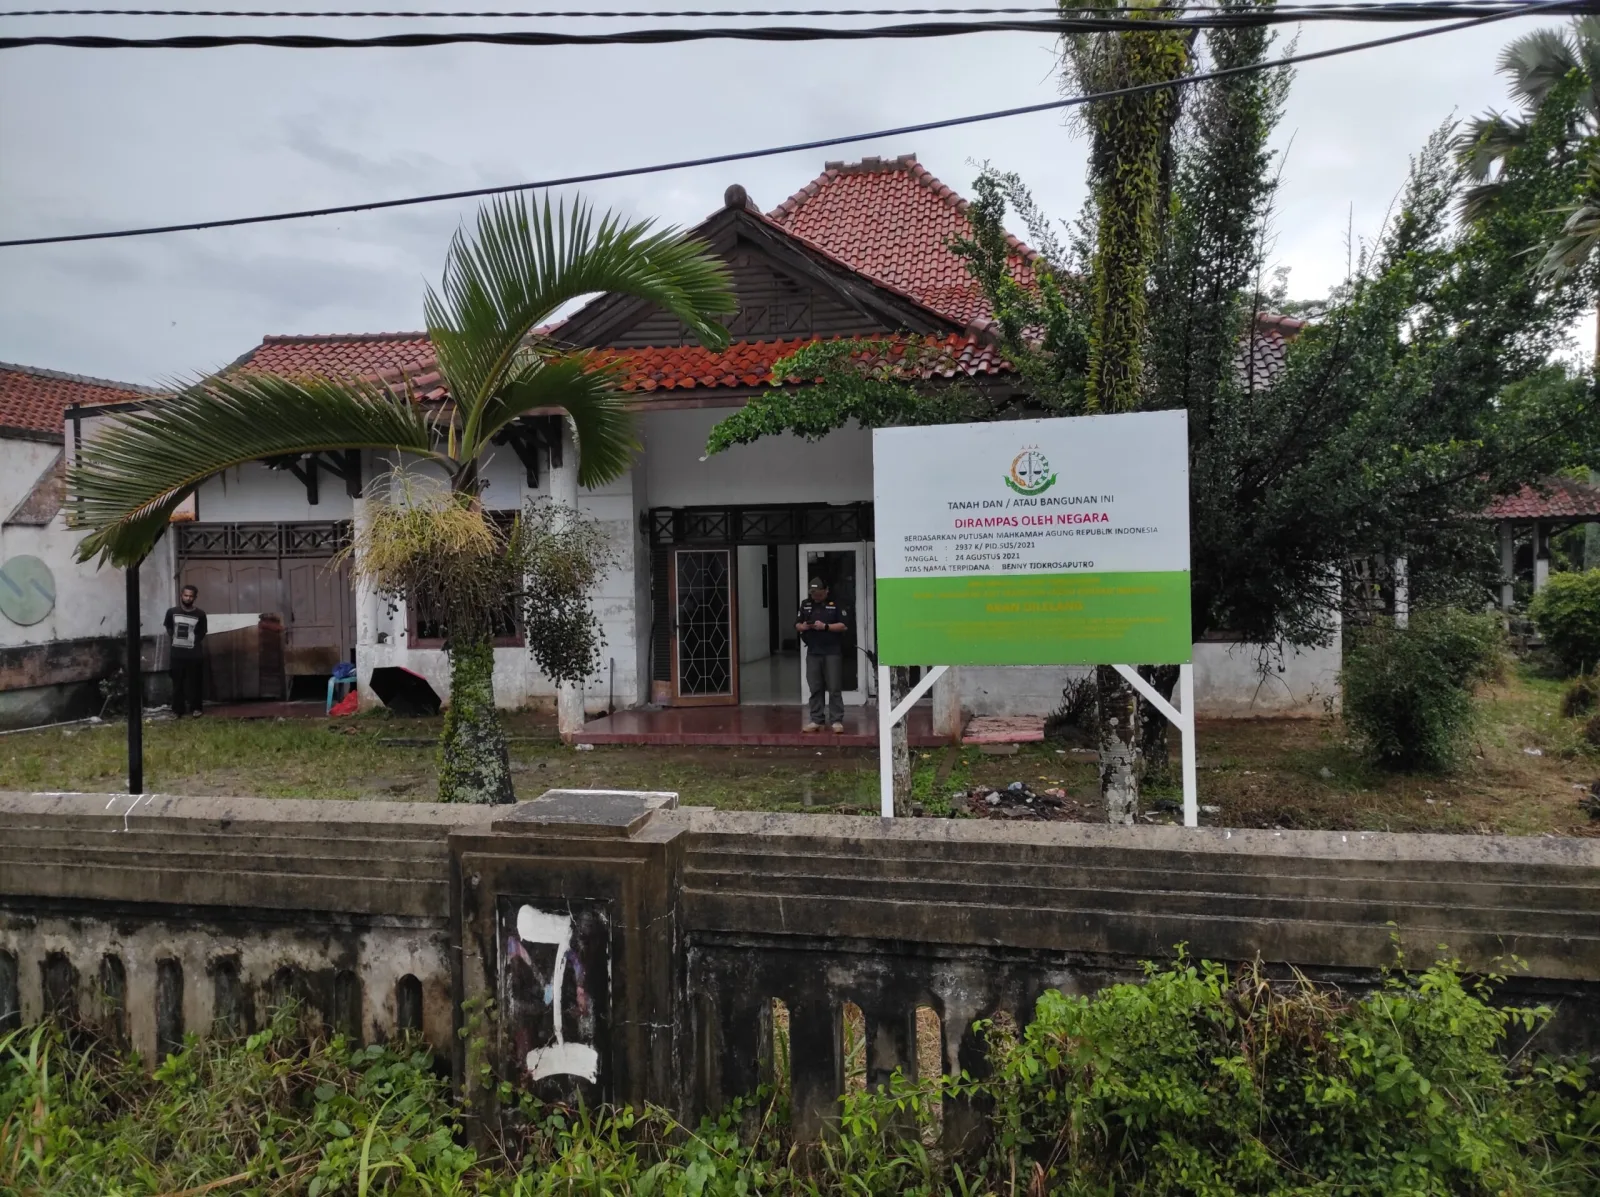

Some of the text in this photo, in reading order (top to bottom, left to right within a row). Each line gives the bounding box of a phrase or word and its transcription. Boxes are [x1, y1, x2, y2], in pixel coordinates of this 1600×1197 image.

[948, 501, 980, 510] TANAH
[982, 499, 1003, 509] DAN
[1013, 498, 1037, 507] ATAU
[1040, 495, 1097, 506] BANGUNAN
[1100, 494, 1114, 503] INI
[955, 512, 1109, 528] DIRAMPAS OLEH NEGARA
[904, 533, 957, 542] BERDASARKAN
[959, 532, 994, 540] PUTUSAN
[1045, 529, 1074, 537] AGUNG
[1076, 528, 1113, 536] REPUBLIK
[1115, 526, 1158, 535] INDONESIA
[955, 543, 973, 551] 2937
[966, 553, 1001, 561] AGUSTUS
[1002, 552, 1020, 560] 2021
[904, 565, 922, 573] ATAS
[923, 565, 947, 573] NAMA
[949, 563, 990, 571] TERPIDANA
[1002, 561, 1027, 570] BENNY
